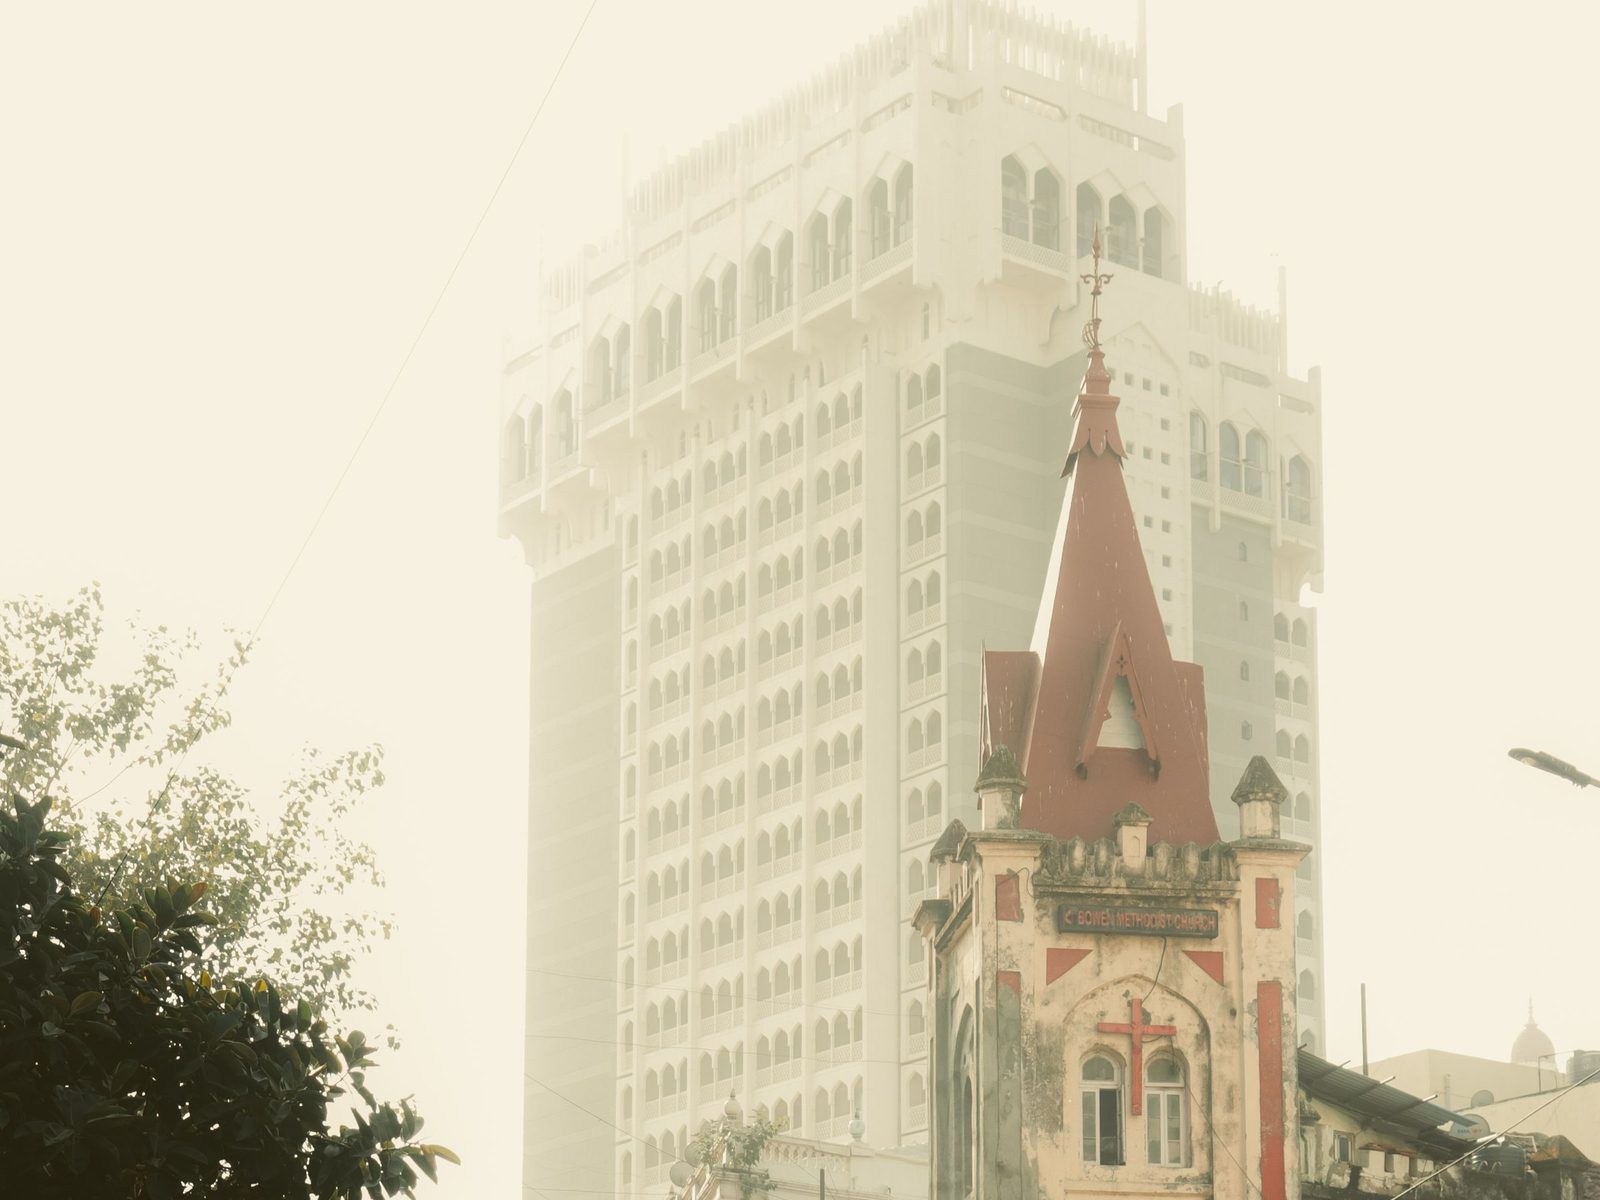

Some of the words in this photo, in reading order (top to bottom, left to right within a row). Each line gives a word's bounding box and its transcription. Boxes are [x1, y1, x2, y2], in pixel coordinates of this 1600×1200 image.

[1077, 910, 1112, 926] BOWEN
[1116, 911, 1172, 929] METHODIST
[1175, 913, 1215, 930] CHURCH
